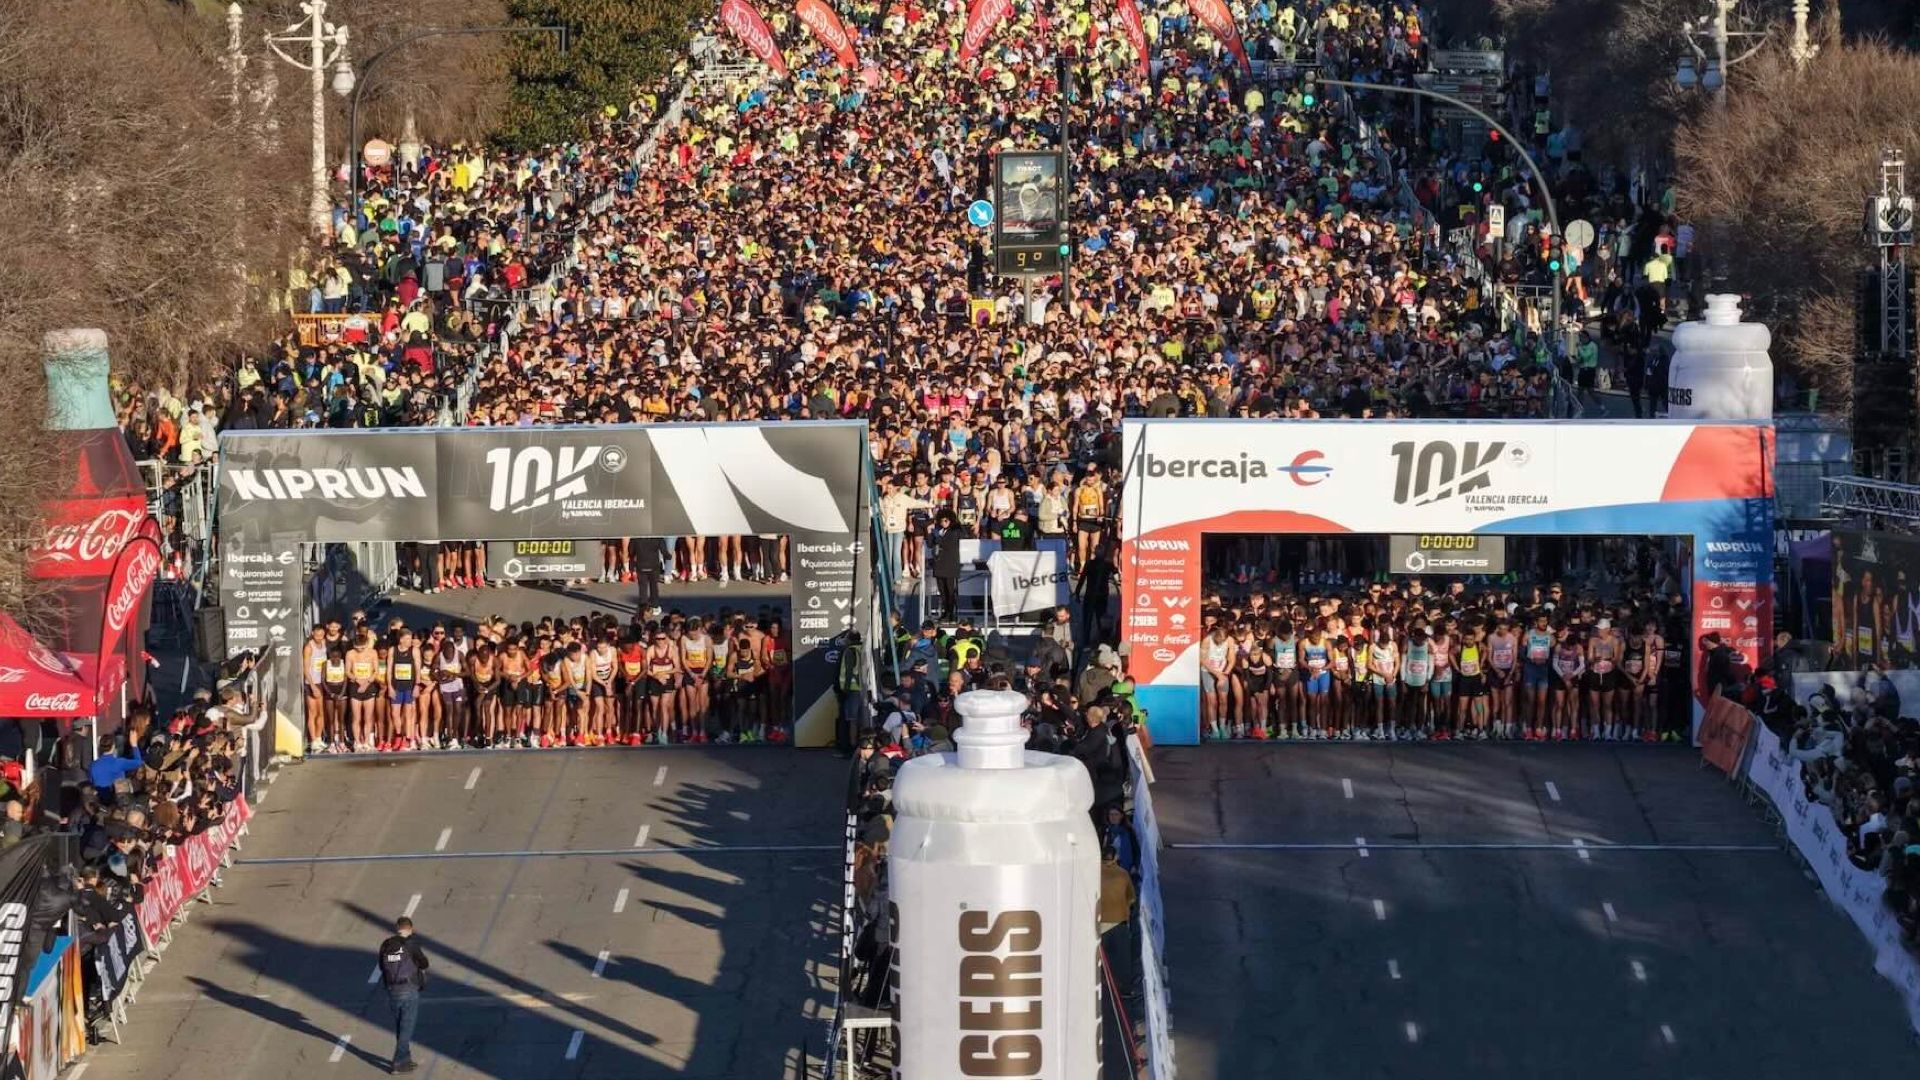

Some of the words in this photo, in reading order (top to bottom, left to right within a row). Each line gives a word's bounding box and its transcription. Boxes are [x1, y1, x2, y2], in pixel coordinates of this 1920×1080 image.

[1136, 452, 1268, 484] Ibercaja
[1391, 440, 1506, 506] 10K
[228, 467, 427, 500] KIPRUN
[486, 446, 602, 514] 10K
[561, 499, 602, 509] VALENCIA
[604, 498, 645, 509] IBERCAJA
[1465, 495, 1505, 504] VALENCIA
[1507, 495, 1548, 504] IBERCAJA
[517, 540, 571, 554] 0:00:00
[797, 542, 842, 554] Ibercaja
[1420, 535, 1475, 549] 0:00:00
[1706, 542, 1763, 552] KIPRUN
[227, 552, 273, 564] Ibercaja
[1427, 558, 1489, 567] COROS
[524, 563, 585, 573] COROS
[107, 543, 157, 631] Coca-Cola
[25, 692, 80, 711] Coca-Cola
[958, 910, 1043, 1080] 6ERS
